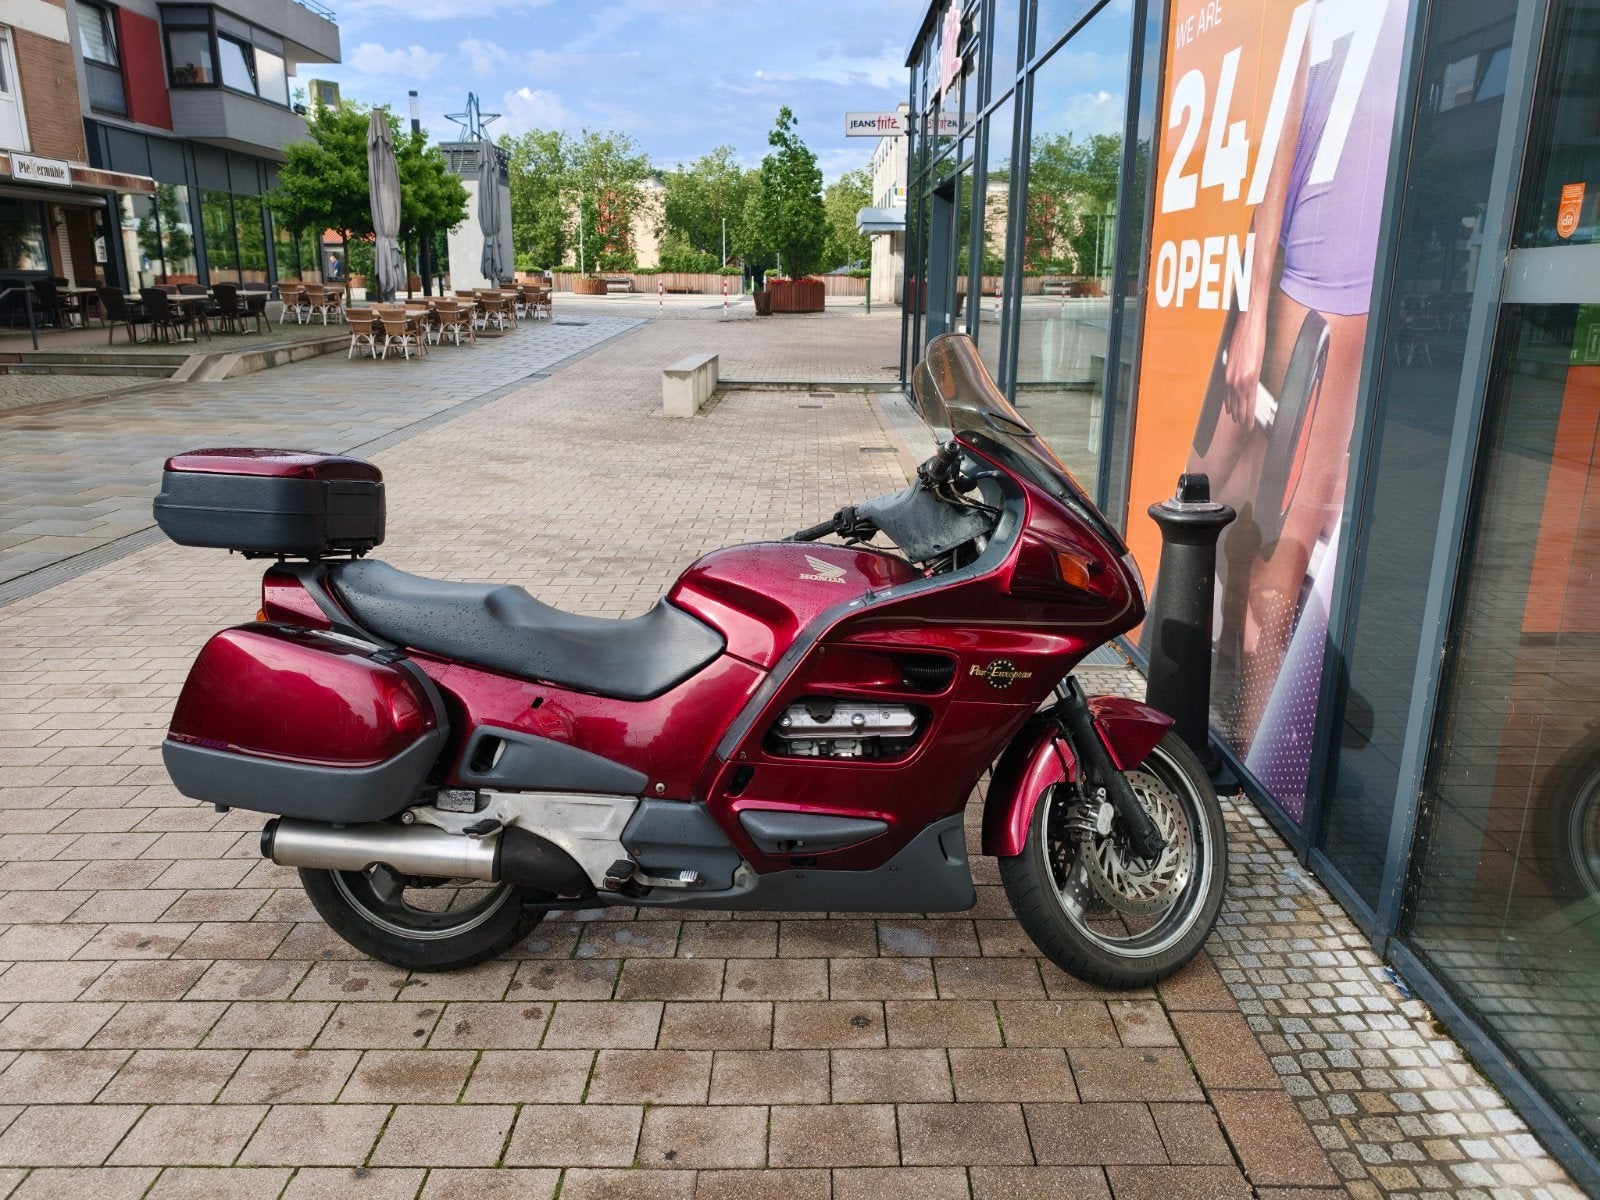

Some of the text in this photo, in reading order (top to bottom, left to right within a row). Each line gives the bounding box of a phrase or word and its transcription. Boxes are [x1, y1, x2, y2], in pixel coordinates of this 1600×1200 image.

[1176, 0, 1223, 50] WE ARE
[850, 116, 900, 131] JEANS fritz
[1161, 0, 1389, 214] 24/7
[1155, 232, 1256, 312] OPEN
[799, 573, 847, 584] HONDA
